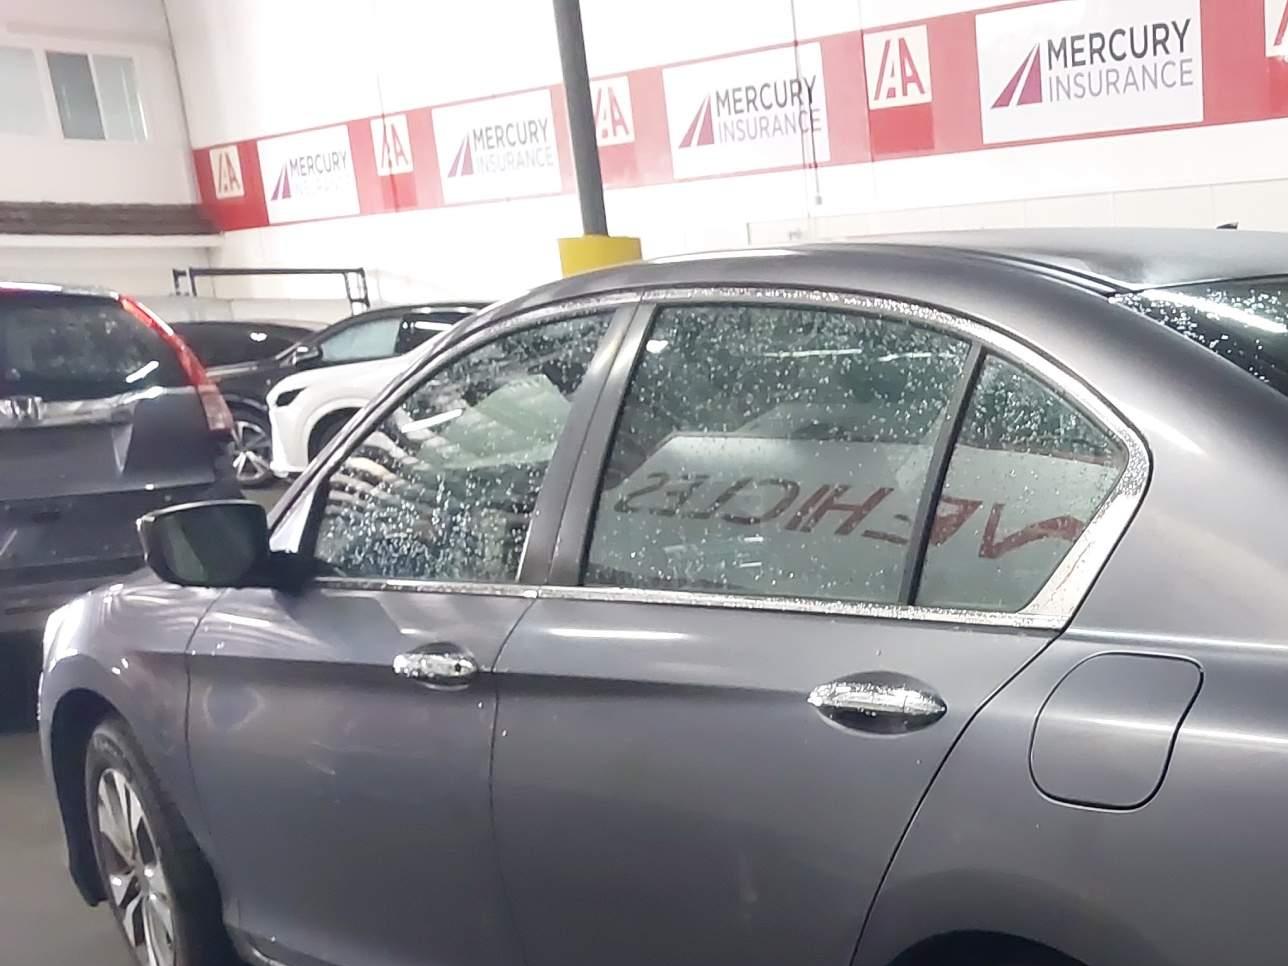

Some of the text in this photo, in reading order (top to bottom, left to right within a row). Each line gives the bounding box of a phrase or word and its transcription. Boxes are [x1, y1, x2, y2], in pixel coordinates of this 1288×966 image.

[1047, 18, 1191, 71] MERCURY
[715, 75, 817, 117] MERCURY
[1048, 58, 1194, 102] INSURANCE
[473, 118, 549, 151] MERCURY
[718, 108, 822, 143] INSURANCE
[290, 151, 347, 177] MERCURY
